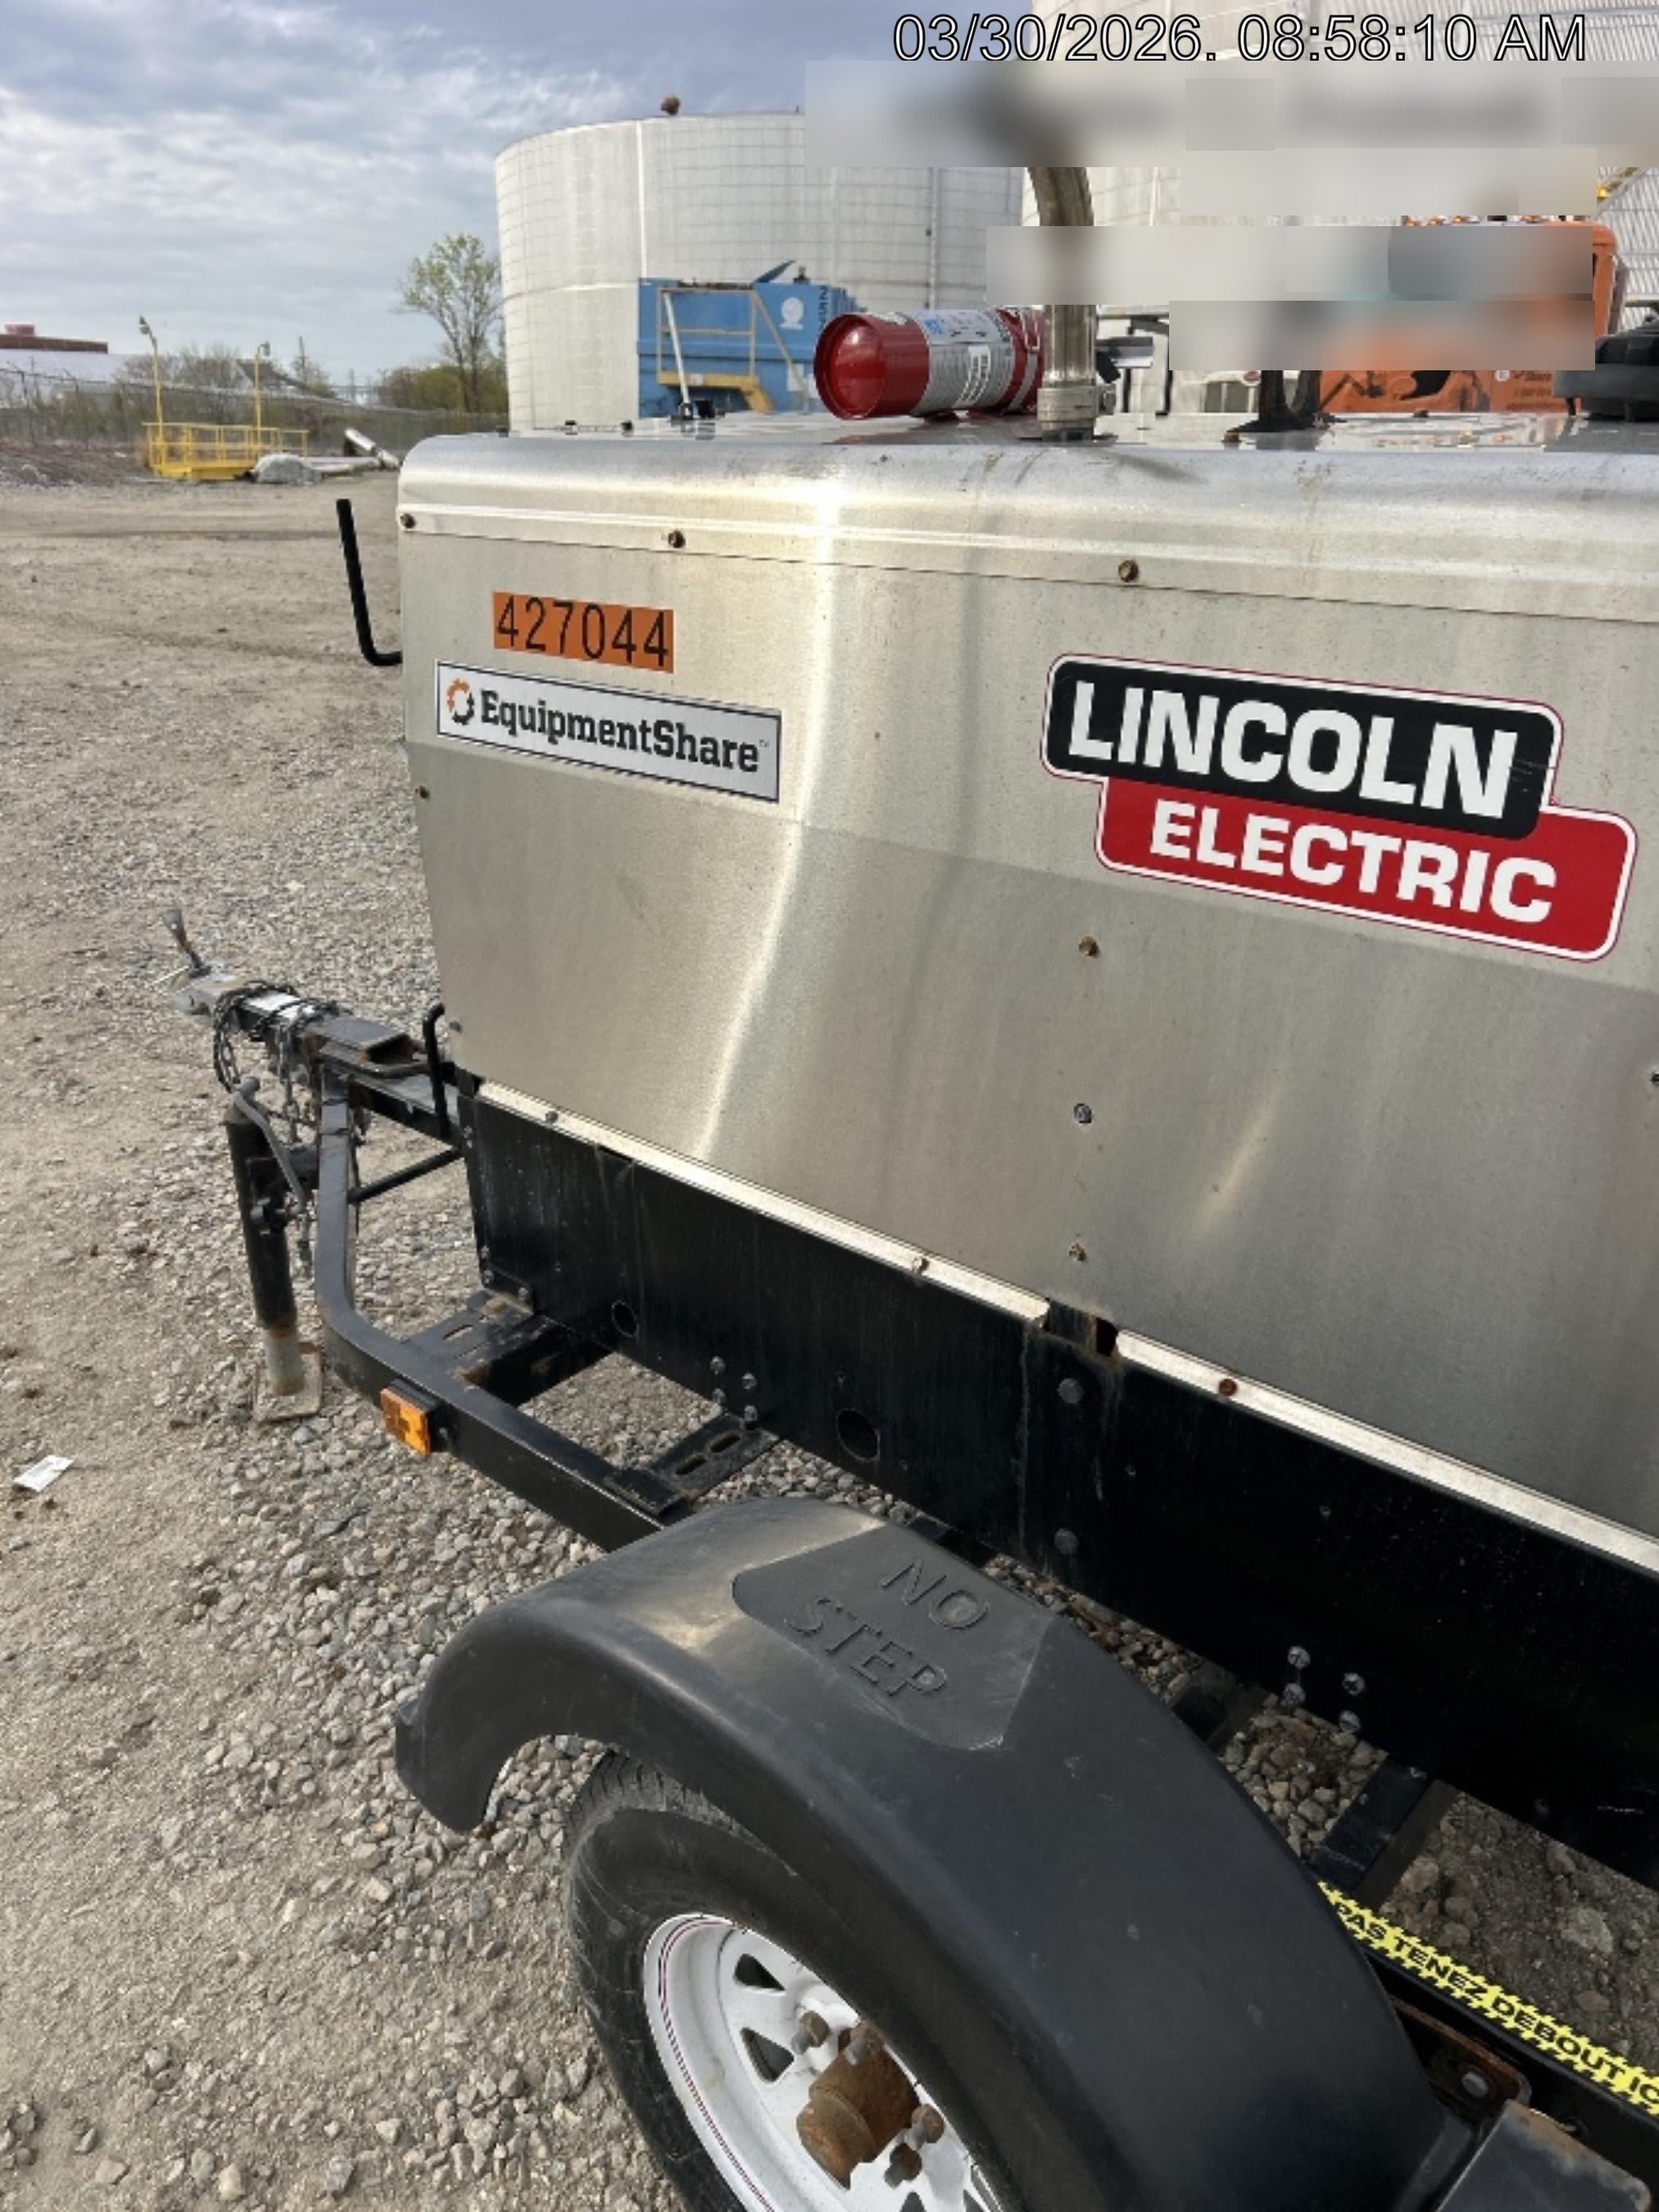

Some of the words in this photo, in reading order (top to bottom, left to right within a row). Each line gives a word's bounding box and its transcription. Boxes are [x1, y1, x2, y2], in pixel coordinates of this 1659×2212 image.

[496, 594, 669, 668] 427044
[480, 689, 759, 773] EquipmentShare
[1067, 681, 1518, 818] LINCOLN
[1149, 798, 1557, 924] ELECTRIC
[881, 1558, 990, 1630] NO
[783, 1596, 948, 1698] STEP
[1394, 1935, 1489, 2002] TENEZ
[1491, 1996, 1627, 2080] DEBOUT
